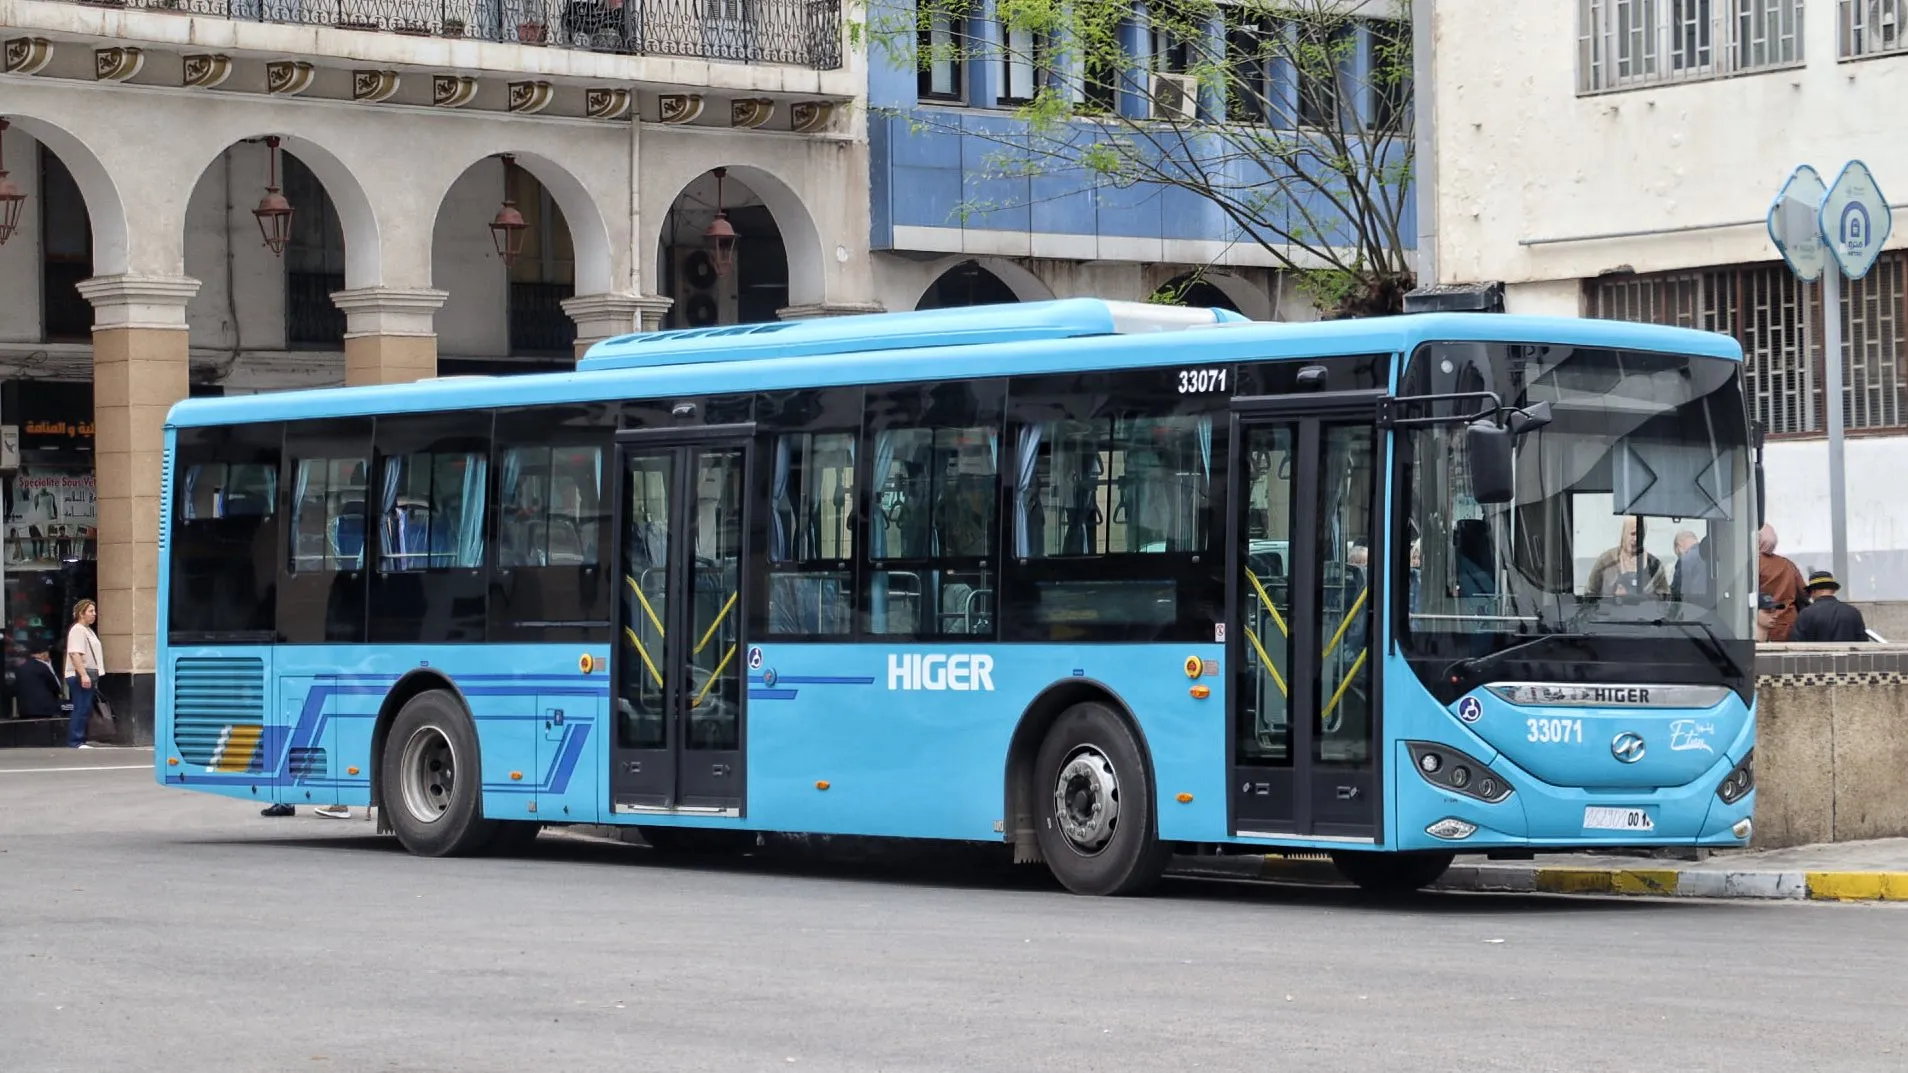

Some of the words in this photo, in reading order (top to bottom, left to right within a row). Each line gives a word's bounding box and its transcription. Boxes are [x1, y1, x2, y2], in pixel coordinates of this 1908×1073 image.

[1178, 368, 1227, 394] 33071
[887, 653, 996, 691] HIGER
[1594, 688, 1650, 703] HIGER
[1526, 718, 1583, 743] 33071
